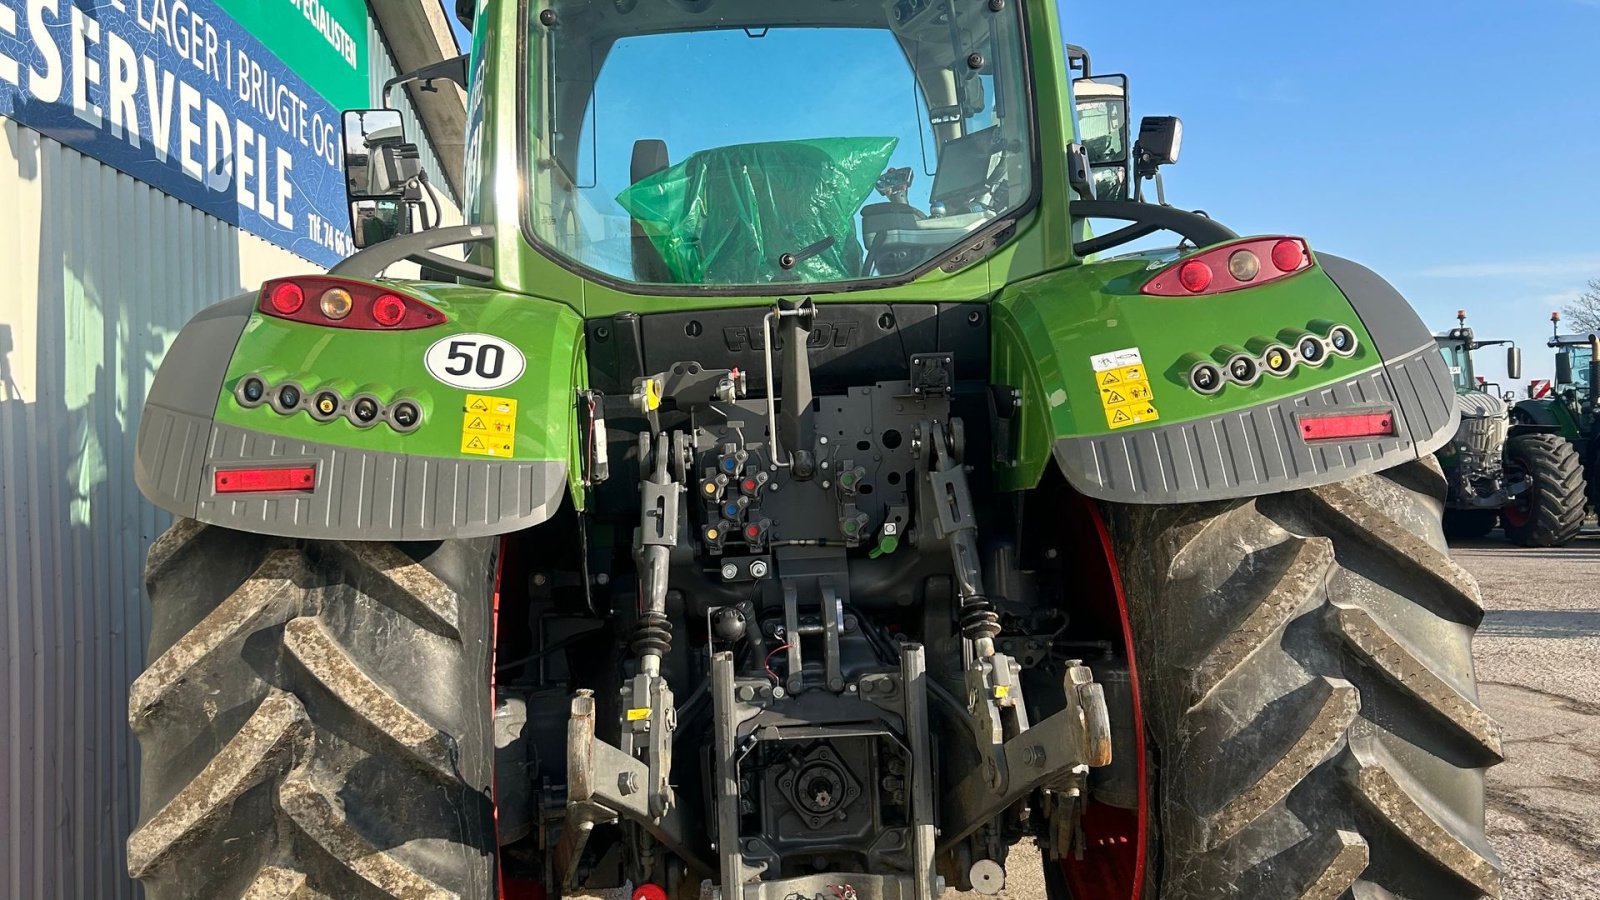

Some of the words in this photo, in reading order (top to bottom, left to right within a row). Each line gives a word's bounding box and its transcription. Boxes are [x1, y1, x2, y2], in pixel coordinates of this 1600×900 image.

[290, 0, 357, 71] ECIALISTEN
[238, 49, 308, 148] BRUGTE
[312, 113, 334, 166] OG
[307, 212, 323, 245] Tlf.
[323, 222, 334, 251] 74
[335, 228, 345, 257] 66
[445, 341, 506, 379] 50
